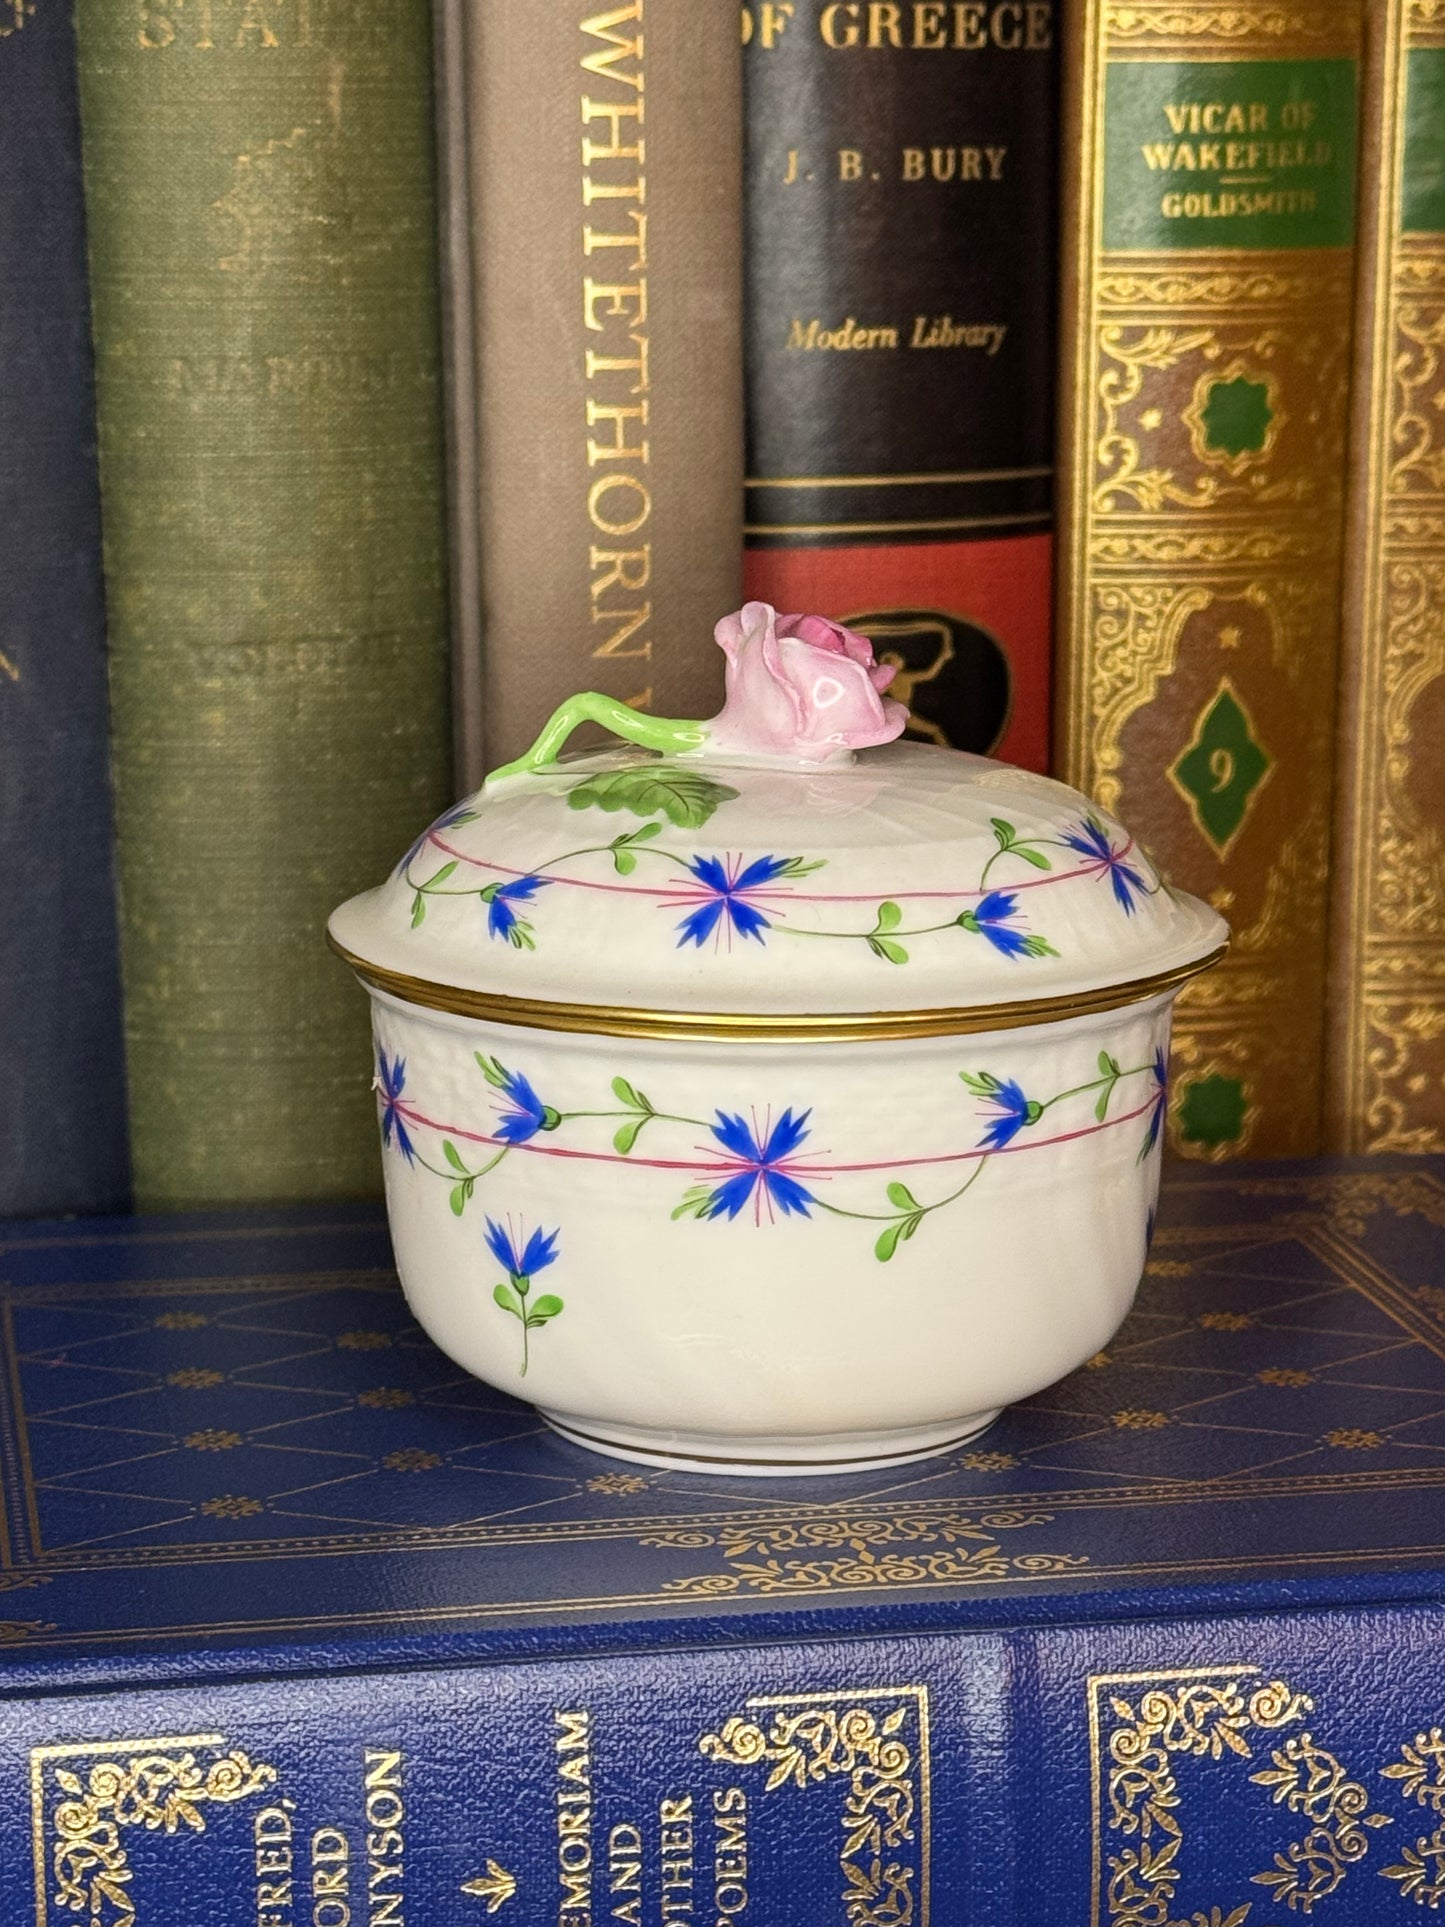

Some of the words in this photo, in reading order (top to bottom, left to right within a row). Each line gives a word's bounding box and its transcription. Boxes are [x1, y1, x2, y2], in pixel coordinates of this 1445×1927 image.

[819, 1, 1052, 49] GREECE
[1163, 103, 1269, 135] VICAR
[1281, 102, 1318, 131] OF
[783, 149, 816, 185] J.
[838, 150, 881, 182] B.
[902, 147, 1006, 182] BURY
[1141, 140, 1332, 171] WAKEFIELD
[1160, 191, 1317, 218] GOLDSMITH
[579, 0, 651, 661] WHITETHORN
[786, 315, 898, 351] Modern
[911, 314, 1006, 356] Library
[1209, 748, 1235, 793] 9
[609, 1823, 641, 1927] AND
[659, 1792, 693, 1927] THER
